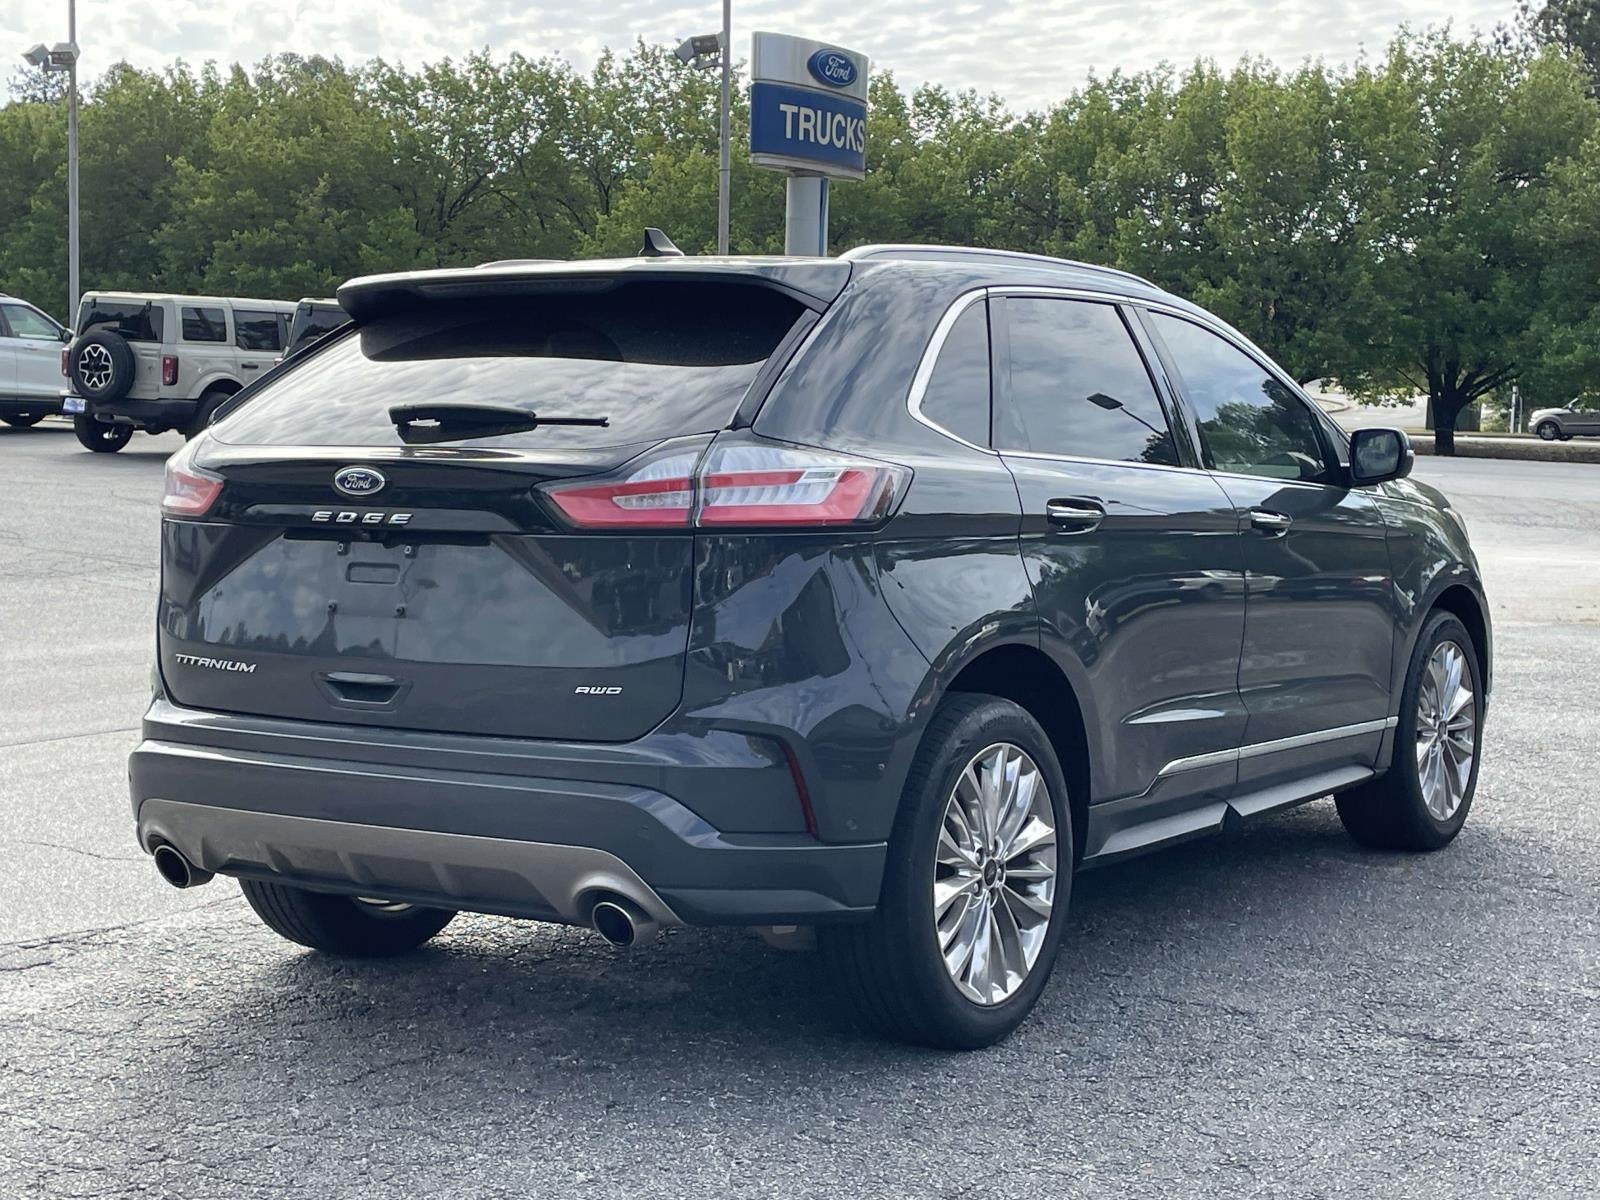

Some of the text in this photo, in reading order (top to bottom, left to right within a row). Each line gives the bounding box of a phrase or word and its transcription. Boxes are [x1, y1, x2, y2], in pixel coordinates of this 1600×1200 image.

[825, 55, 850, 80] Ford
[779, 103, 865, 153] TRUCKS
[344, 473, 371, 489] Ford
[311, 511, 412, 524] EDGE
[175, 653, 257, 673] TITANIUM
[574, 686, 623, 695] AWD
